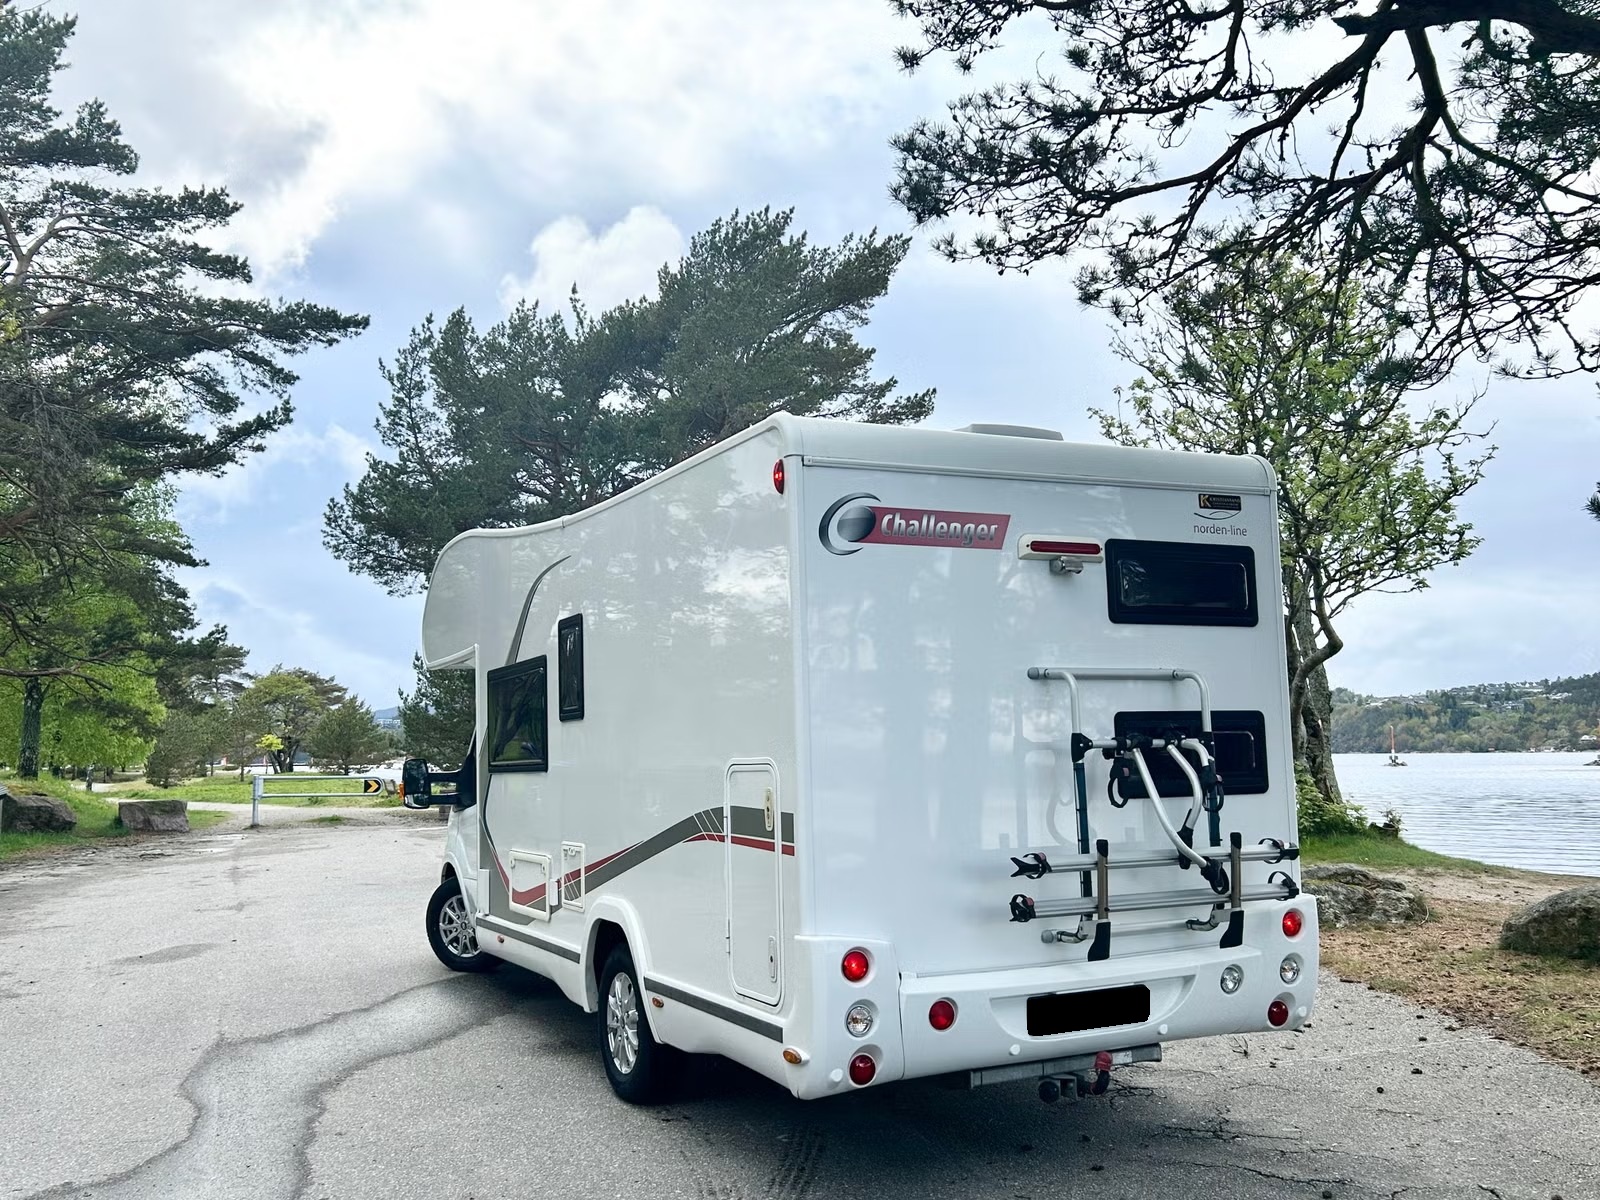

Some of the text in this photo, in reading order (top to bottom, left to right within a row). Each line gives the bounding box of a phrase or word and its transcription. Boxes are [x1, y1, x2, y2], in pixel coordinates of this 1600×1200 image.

[1200, 494, 1212, 507] K
[881, 512, 998, 546] Challenger
[1193, 524, 1247, 536] norden-line
